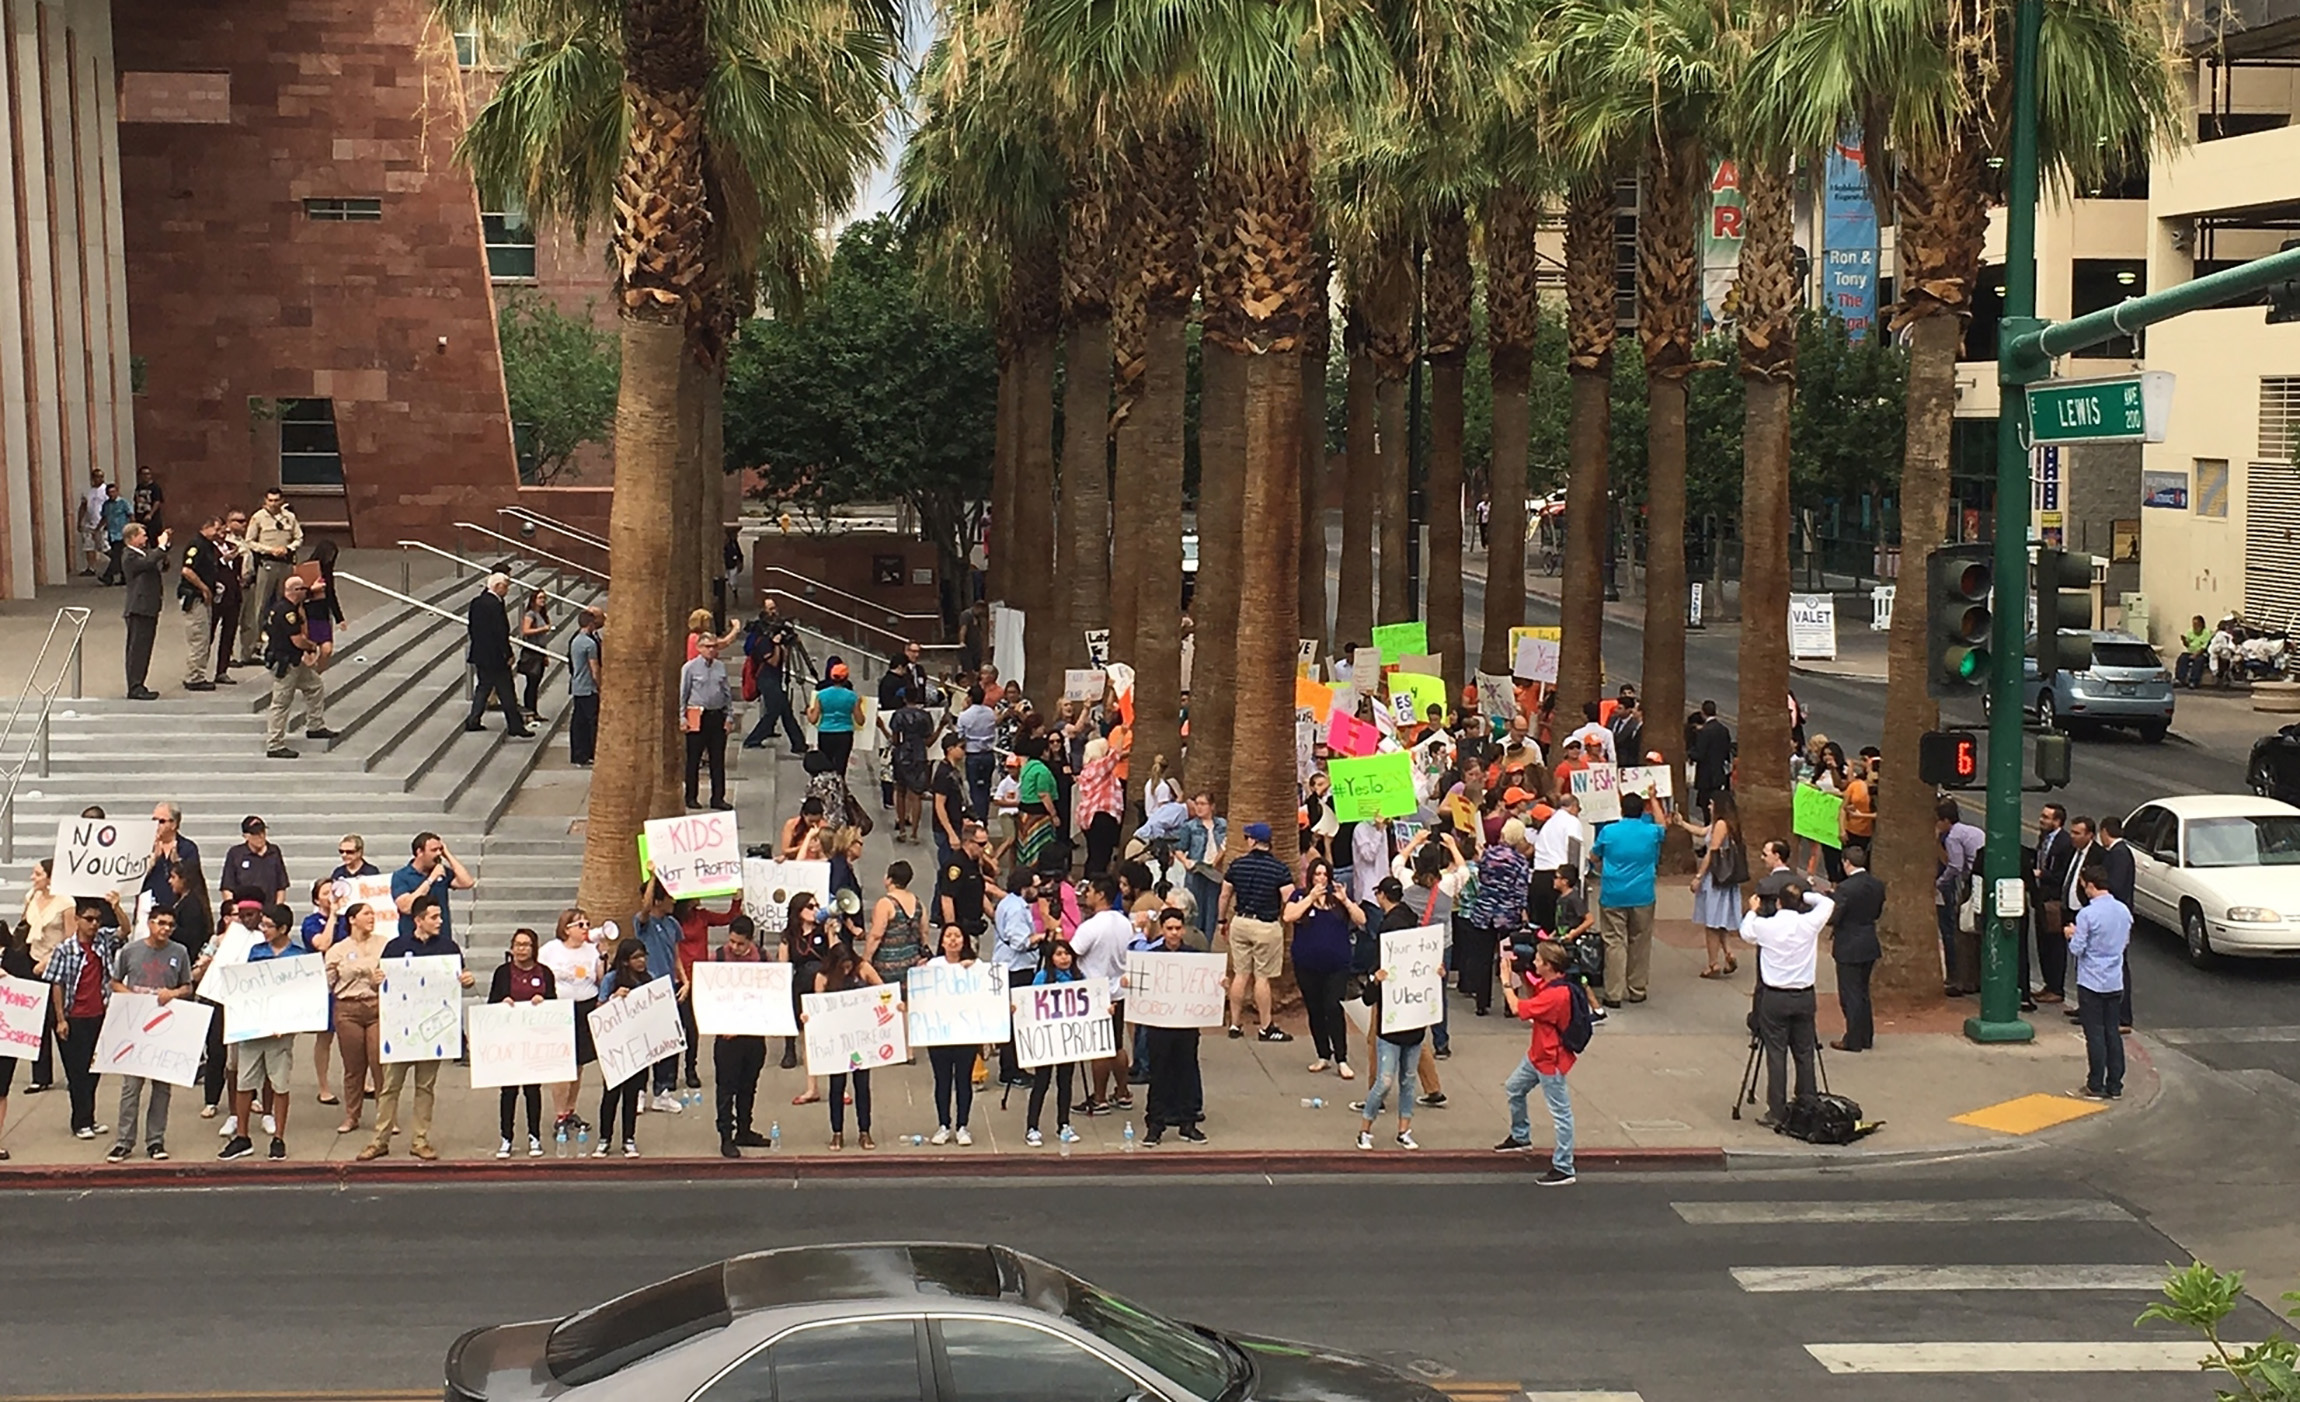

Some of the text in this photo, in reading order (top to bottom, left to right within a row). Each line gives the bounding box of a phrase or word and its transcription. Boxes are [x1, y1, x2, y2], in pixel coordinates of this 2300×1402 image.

[1830, 250, 1872, 264] Ron &
[1834, 271, 1867, 289] Tony
[1838, 293, 1863, 307] The
[2030, 386, 2139, 428] E LEWIS AVE
[2125, 409, 2141, 429] 200
[1793, 610, 1832, 624] VALET
[1958, 741, 1975, 775] 6
[73, 822, 117, 848] NO
[668, 817, 724, 855] KIDS
[1417, 937, 1440, 953] tax
[1409, 960, 1431, 979] for
[1033, 986, 1090, 1021] KIDS
[1392, 985, 1434, 1005] Uber
[108, 999, 175, 1038] NO
[1017, 1017, 1112, 1060] NOT PROFIT
